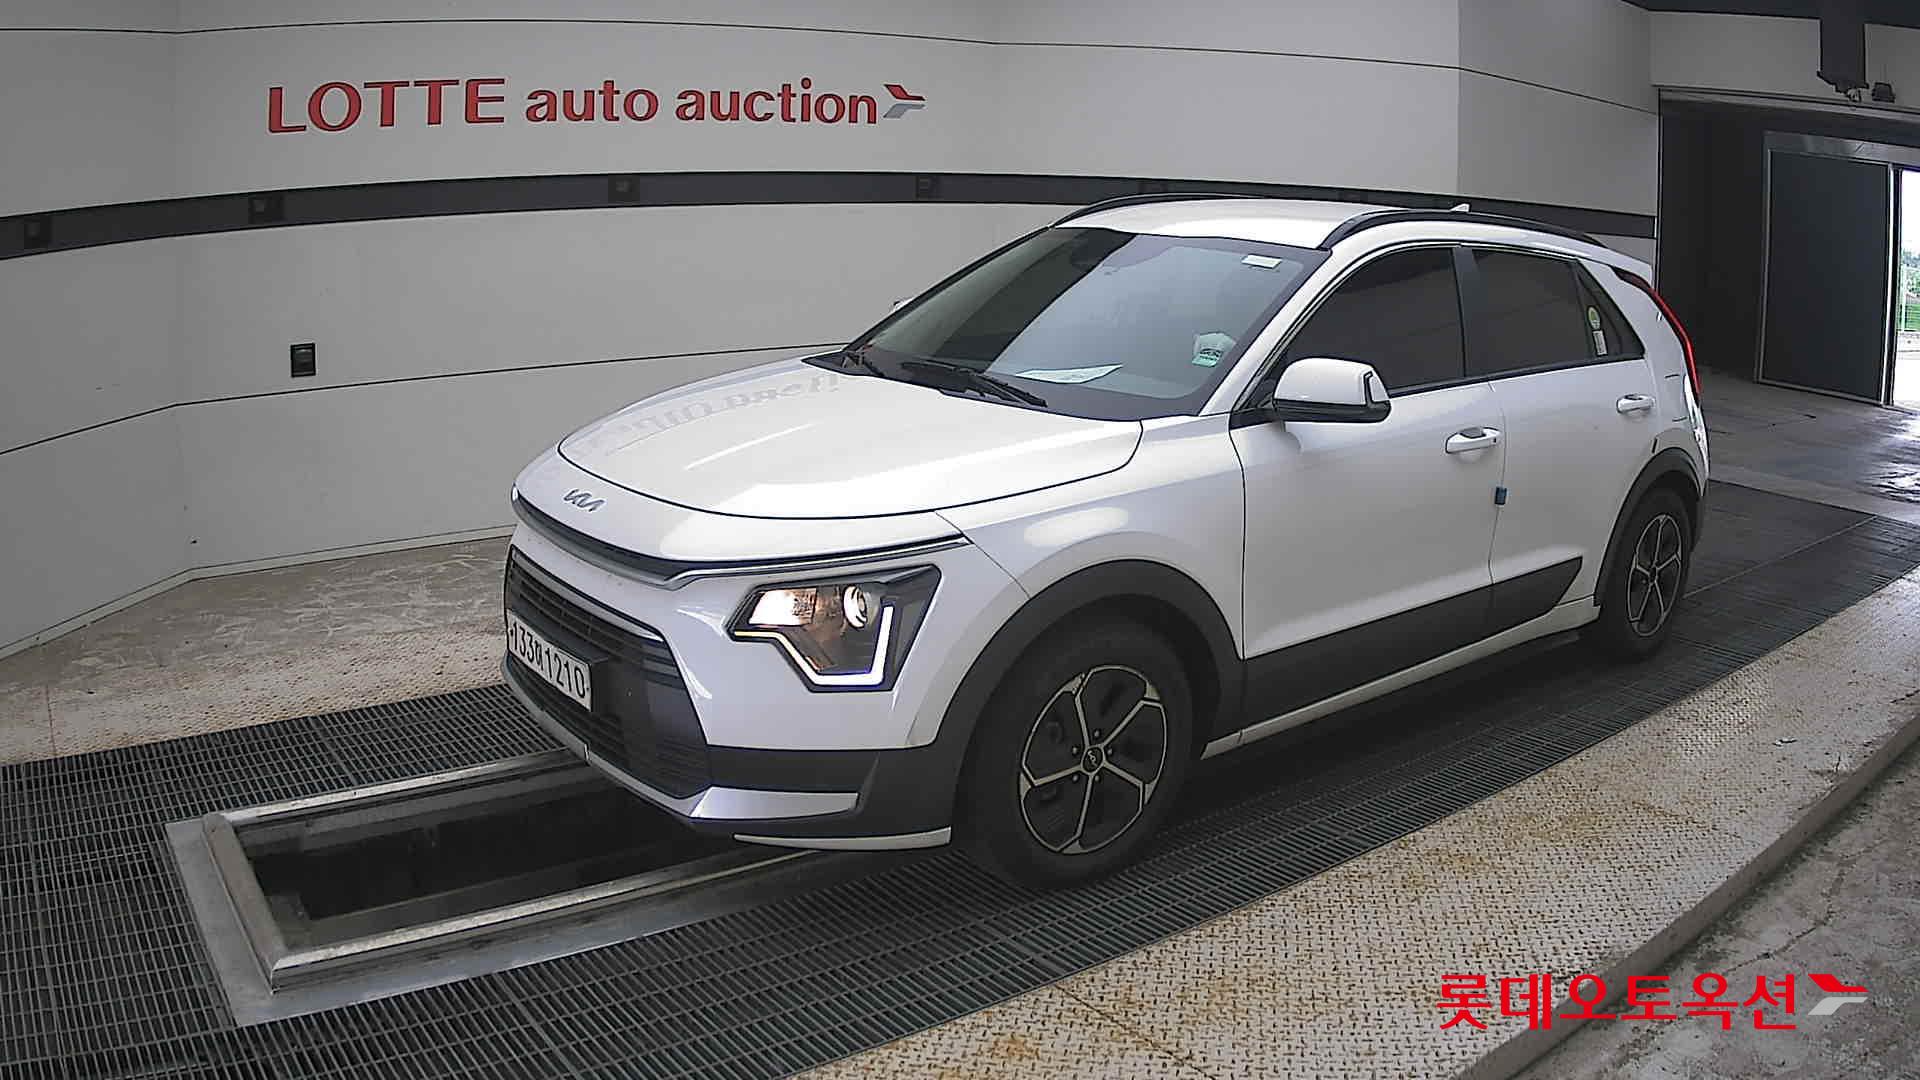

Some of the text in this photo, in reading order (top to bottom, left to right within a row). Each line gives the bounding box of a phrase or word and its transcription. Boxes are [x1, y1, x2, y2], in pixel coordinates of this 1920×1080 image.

[267, 77, 878, 134] LOTTE auto auction
